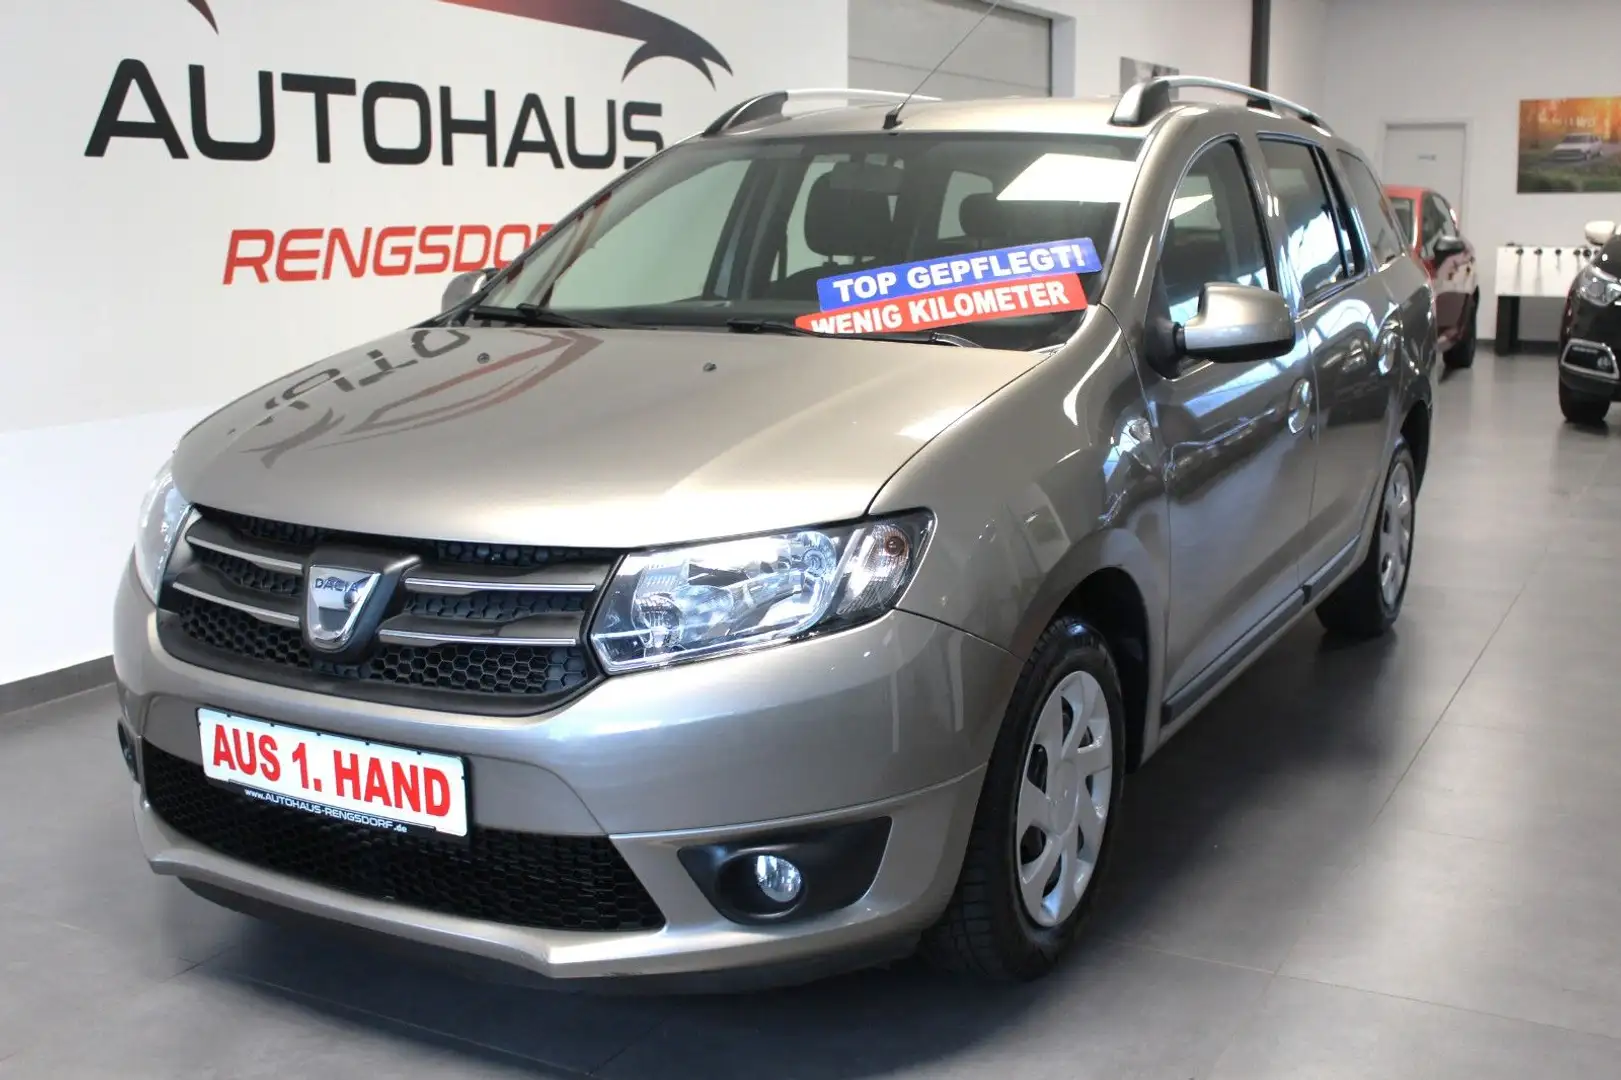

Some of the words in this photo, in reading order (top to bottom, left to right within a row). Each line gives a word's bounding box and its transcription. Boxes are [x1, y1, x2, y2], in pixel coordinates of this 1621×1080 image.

[84, 58, 664, 170] AUTOHAUS
[223, 223, 556, 285] RENGSDO
[833, 272, 897, 303] TOP
[907, 244, 1086, 290] GEPFLEGT!
[811, 304, 903, 334] WENIG
[909, 280, 1070, 325] KILOMETER
[314, 577, 358, 593] DACIA
[213, 724, 281, 782] AUS
[292, 742, 322, 792] 1.
[333, 750, 451, 817] HAND
